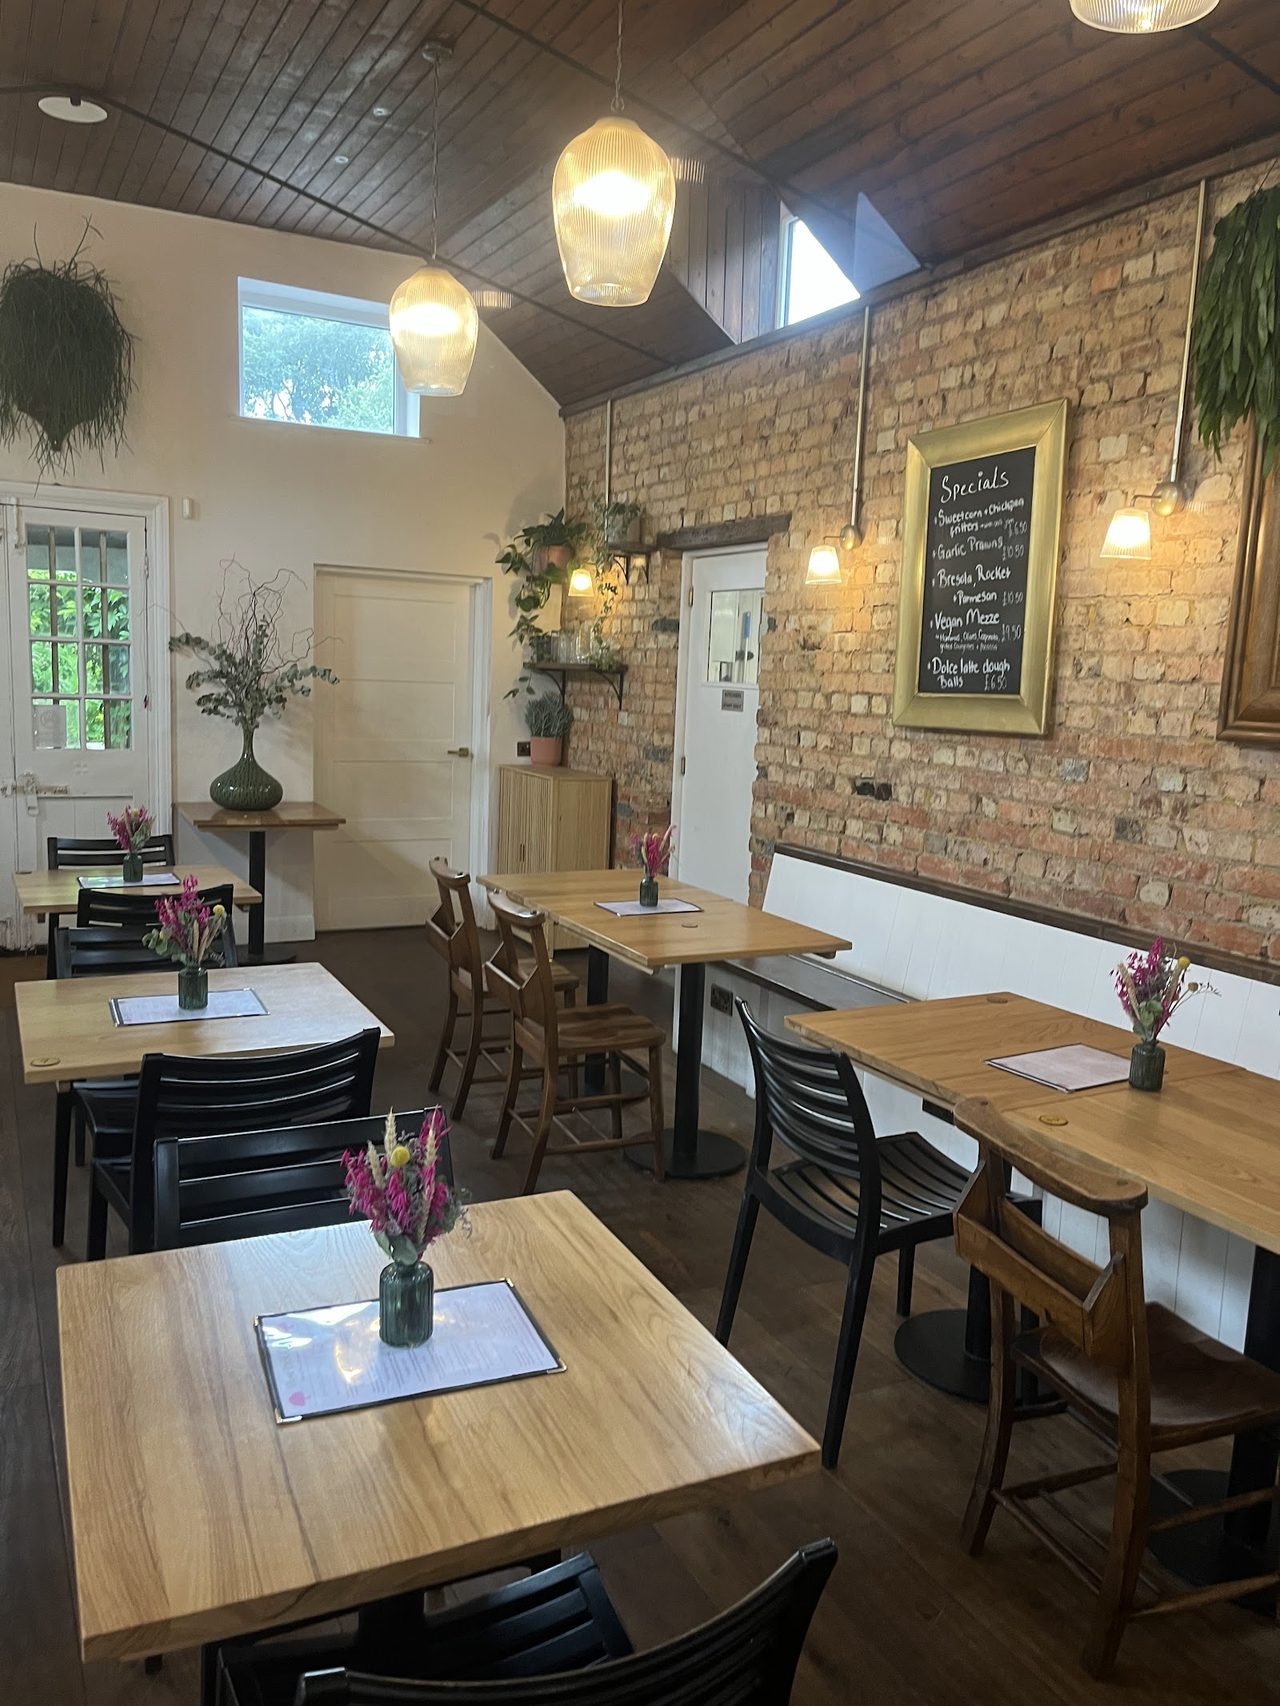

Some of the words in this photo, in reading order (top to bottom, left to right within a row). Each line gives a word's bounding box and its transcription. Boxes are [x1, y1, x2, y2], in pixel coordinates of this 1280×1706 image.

[941, 466, 1009, 504] Specials
[938, 508, 982, 527] Sweetcorn
[937, 543, 967, 561] Garlic
[967, 536, 1003, 551] Prawns
[975, 563, 1012, 581] Rocket
[935, 610, 963, 636] Vegan
[966, 608, 1000, 626] Mezze
[932, 656, 958, 675] Dolce
[982, 658, 1011, 678] dough
[937, 674, 963, 689] Balls
